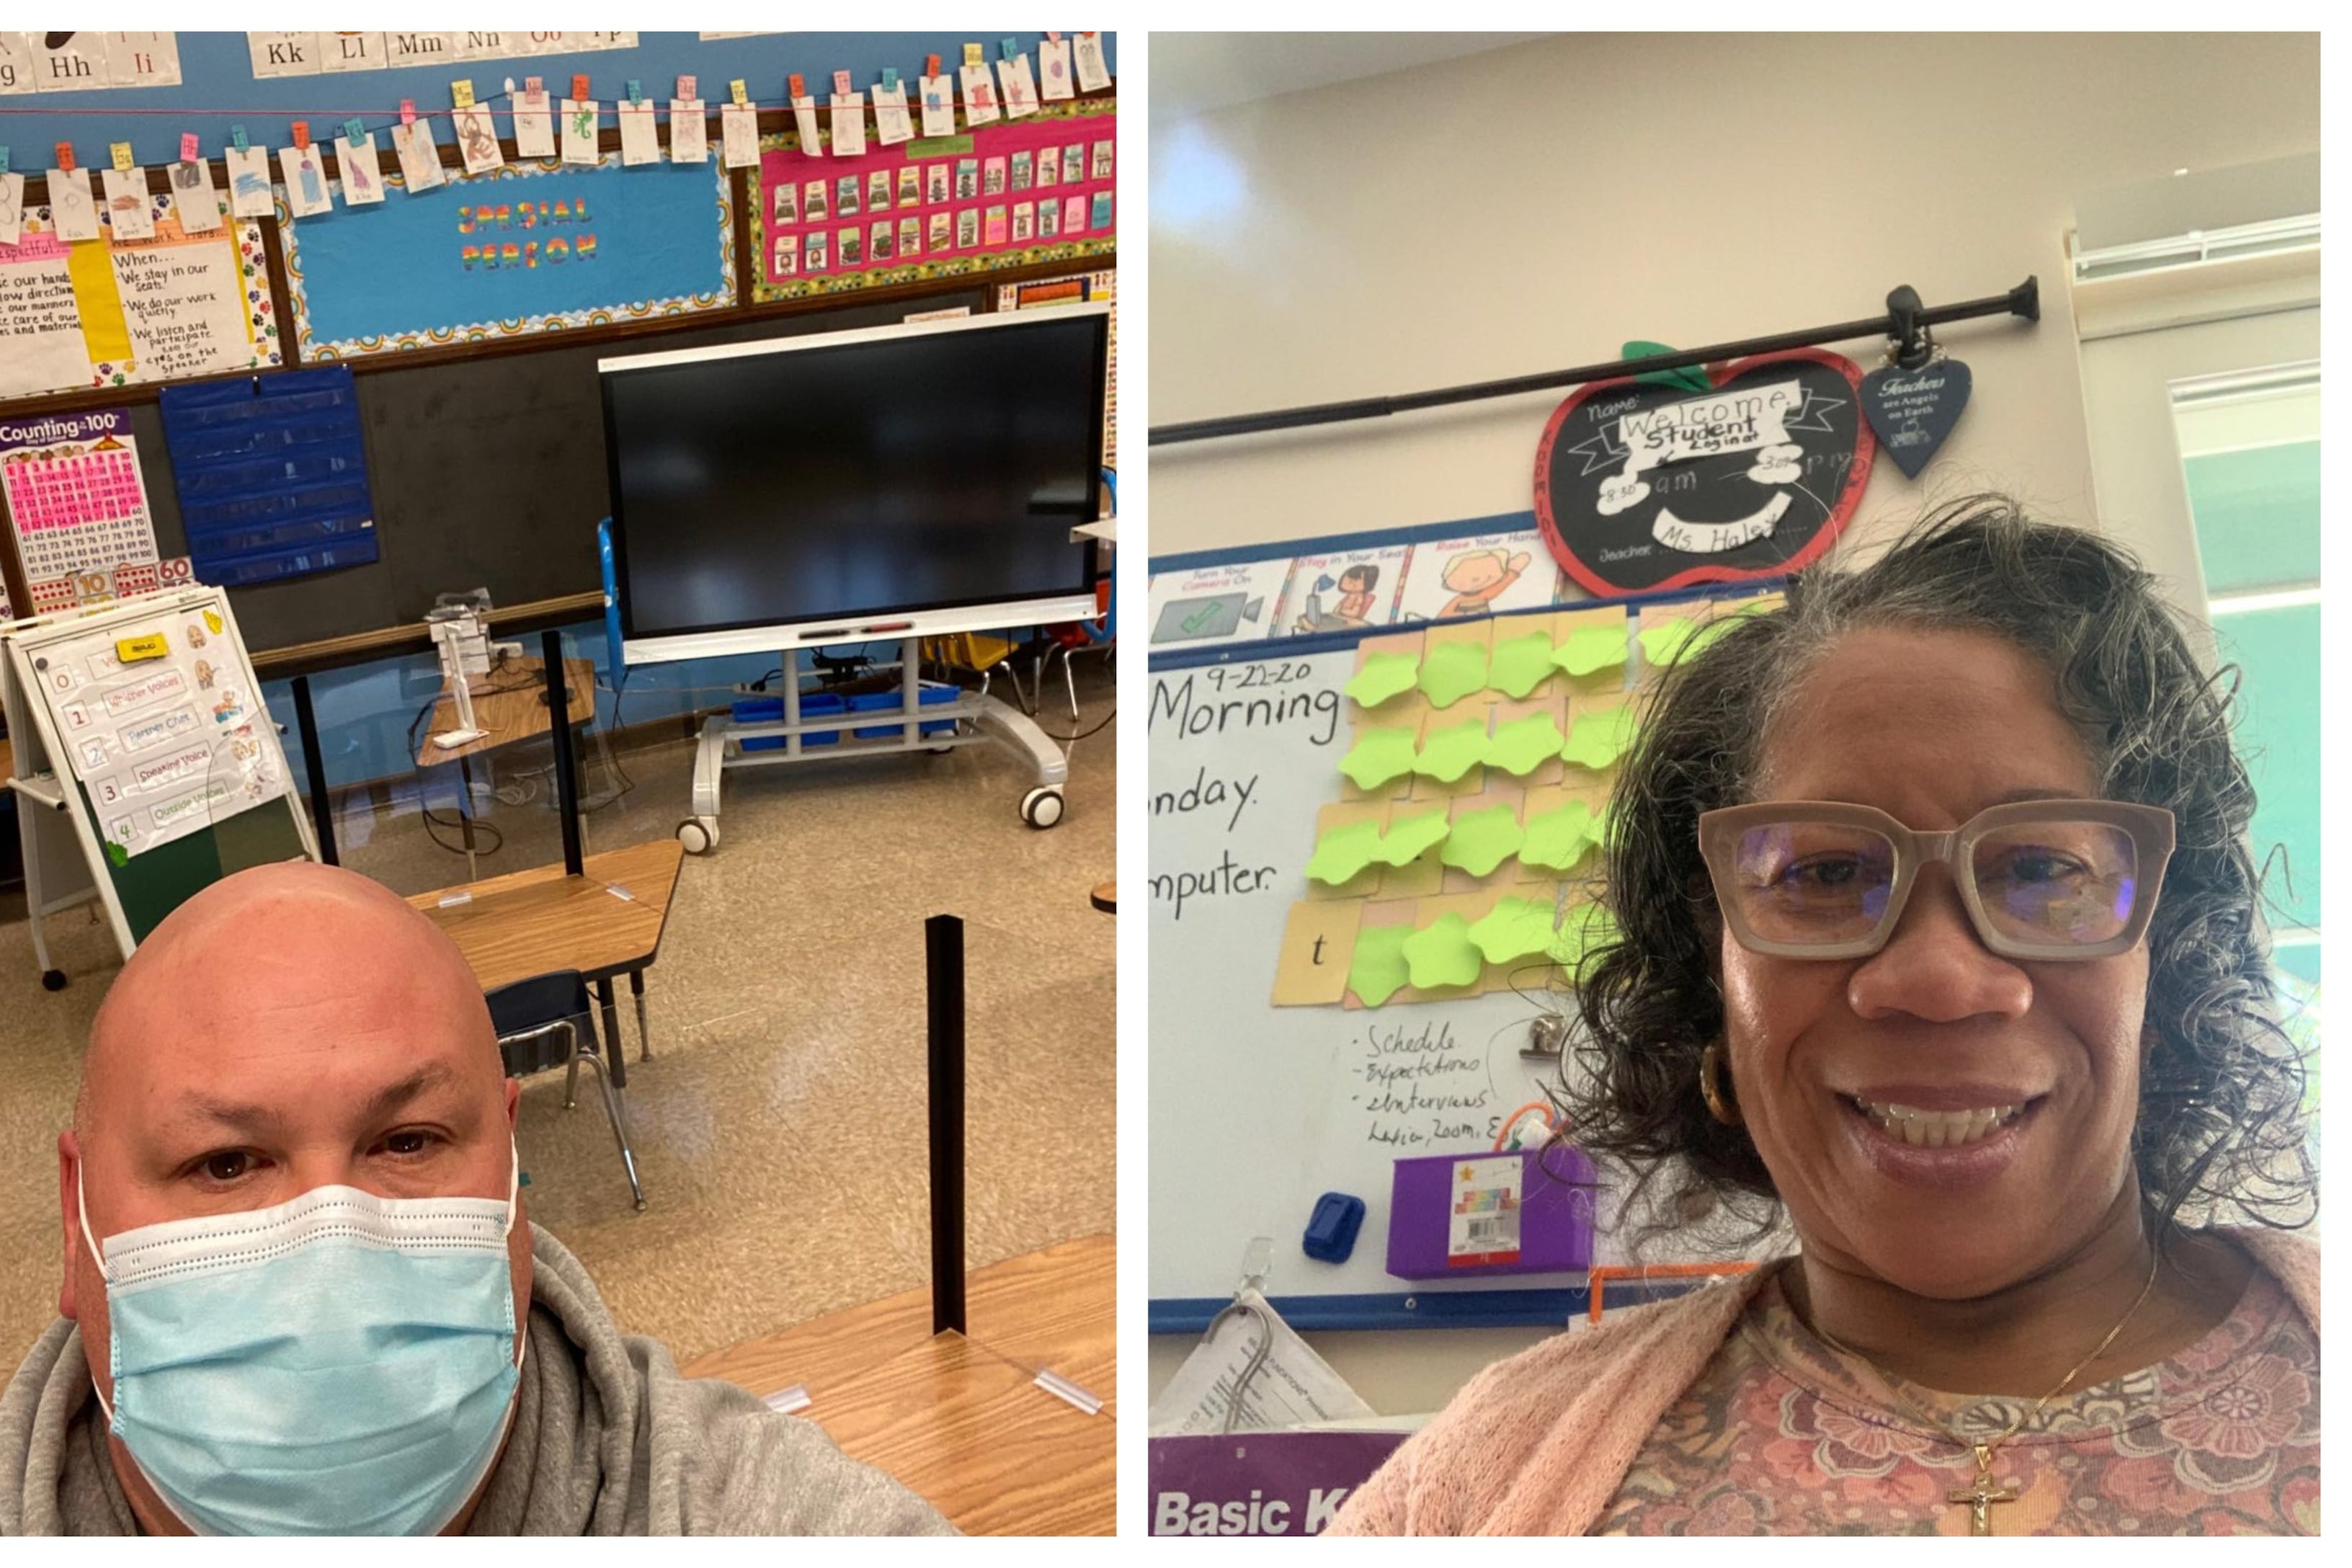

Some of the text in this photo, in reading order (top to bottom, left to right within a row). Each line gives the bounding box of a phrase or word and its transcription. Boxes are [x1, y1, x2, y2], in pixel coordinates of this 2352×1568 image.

[340, 37, 366, 59] Ll
[398, 34, 442, 55] Mm
[468, 31, 500, 48] Nn
[267, 43, 304, 64] Kk
[50, 55, 92, 77] Hh
[458, 197, 592, 234] SPECIAL
[462, 233, 597, 271] PERSON
[14, 277, 37, 288] our
[120, 264, 210, 285] We stay in our
[8, 304, 27, 313] our
[126, 293, 217, 311] We do our work
[13, 316, 40, 325] care
[42, 312, 53, 322] of
[14, 324, 35, 334] and
[133, 319, 208, 340] We listen and
[198, 347, 218, 357] the
[0, 419, 79, 442] Counting
[1644, 415, 1757, 450] Student
[132, 507, 142, 515] 60
[22, 534, 31, 543] 61
[47, 530, 57, 539] 63
[72, 527, 82, 535] 65
[97, 523, 107, 532] 67
[134, 517, 145, 526] 70
[24, 545, 34, 553] 71
[37, 543, 47, 551] 72
[74, 538, 85, 546] 75
[99, 534, 110, 543] 77
[52, 552, 62, 561] 83
[77, 548, 87, 557] 85
[1298, 557, 1327, 569] Stay
[1345, 550, 1375, 564] Your
[160, 558, 189, 579] 60
[79, 574, 105, 595] 10
[72, 710, 85, 725] 1
[1148, 674, 1340, 746] Morning
[89, 748, 102, 764] 2
[105, 785, 116, 801] 3
[1148, 766, 1259, 832] nday.
[120, 824, 130, 839] 4
[1311, 932, 1326, 966] t
[1153, 1489, 1291, 1536] Basic
